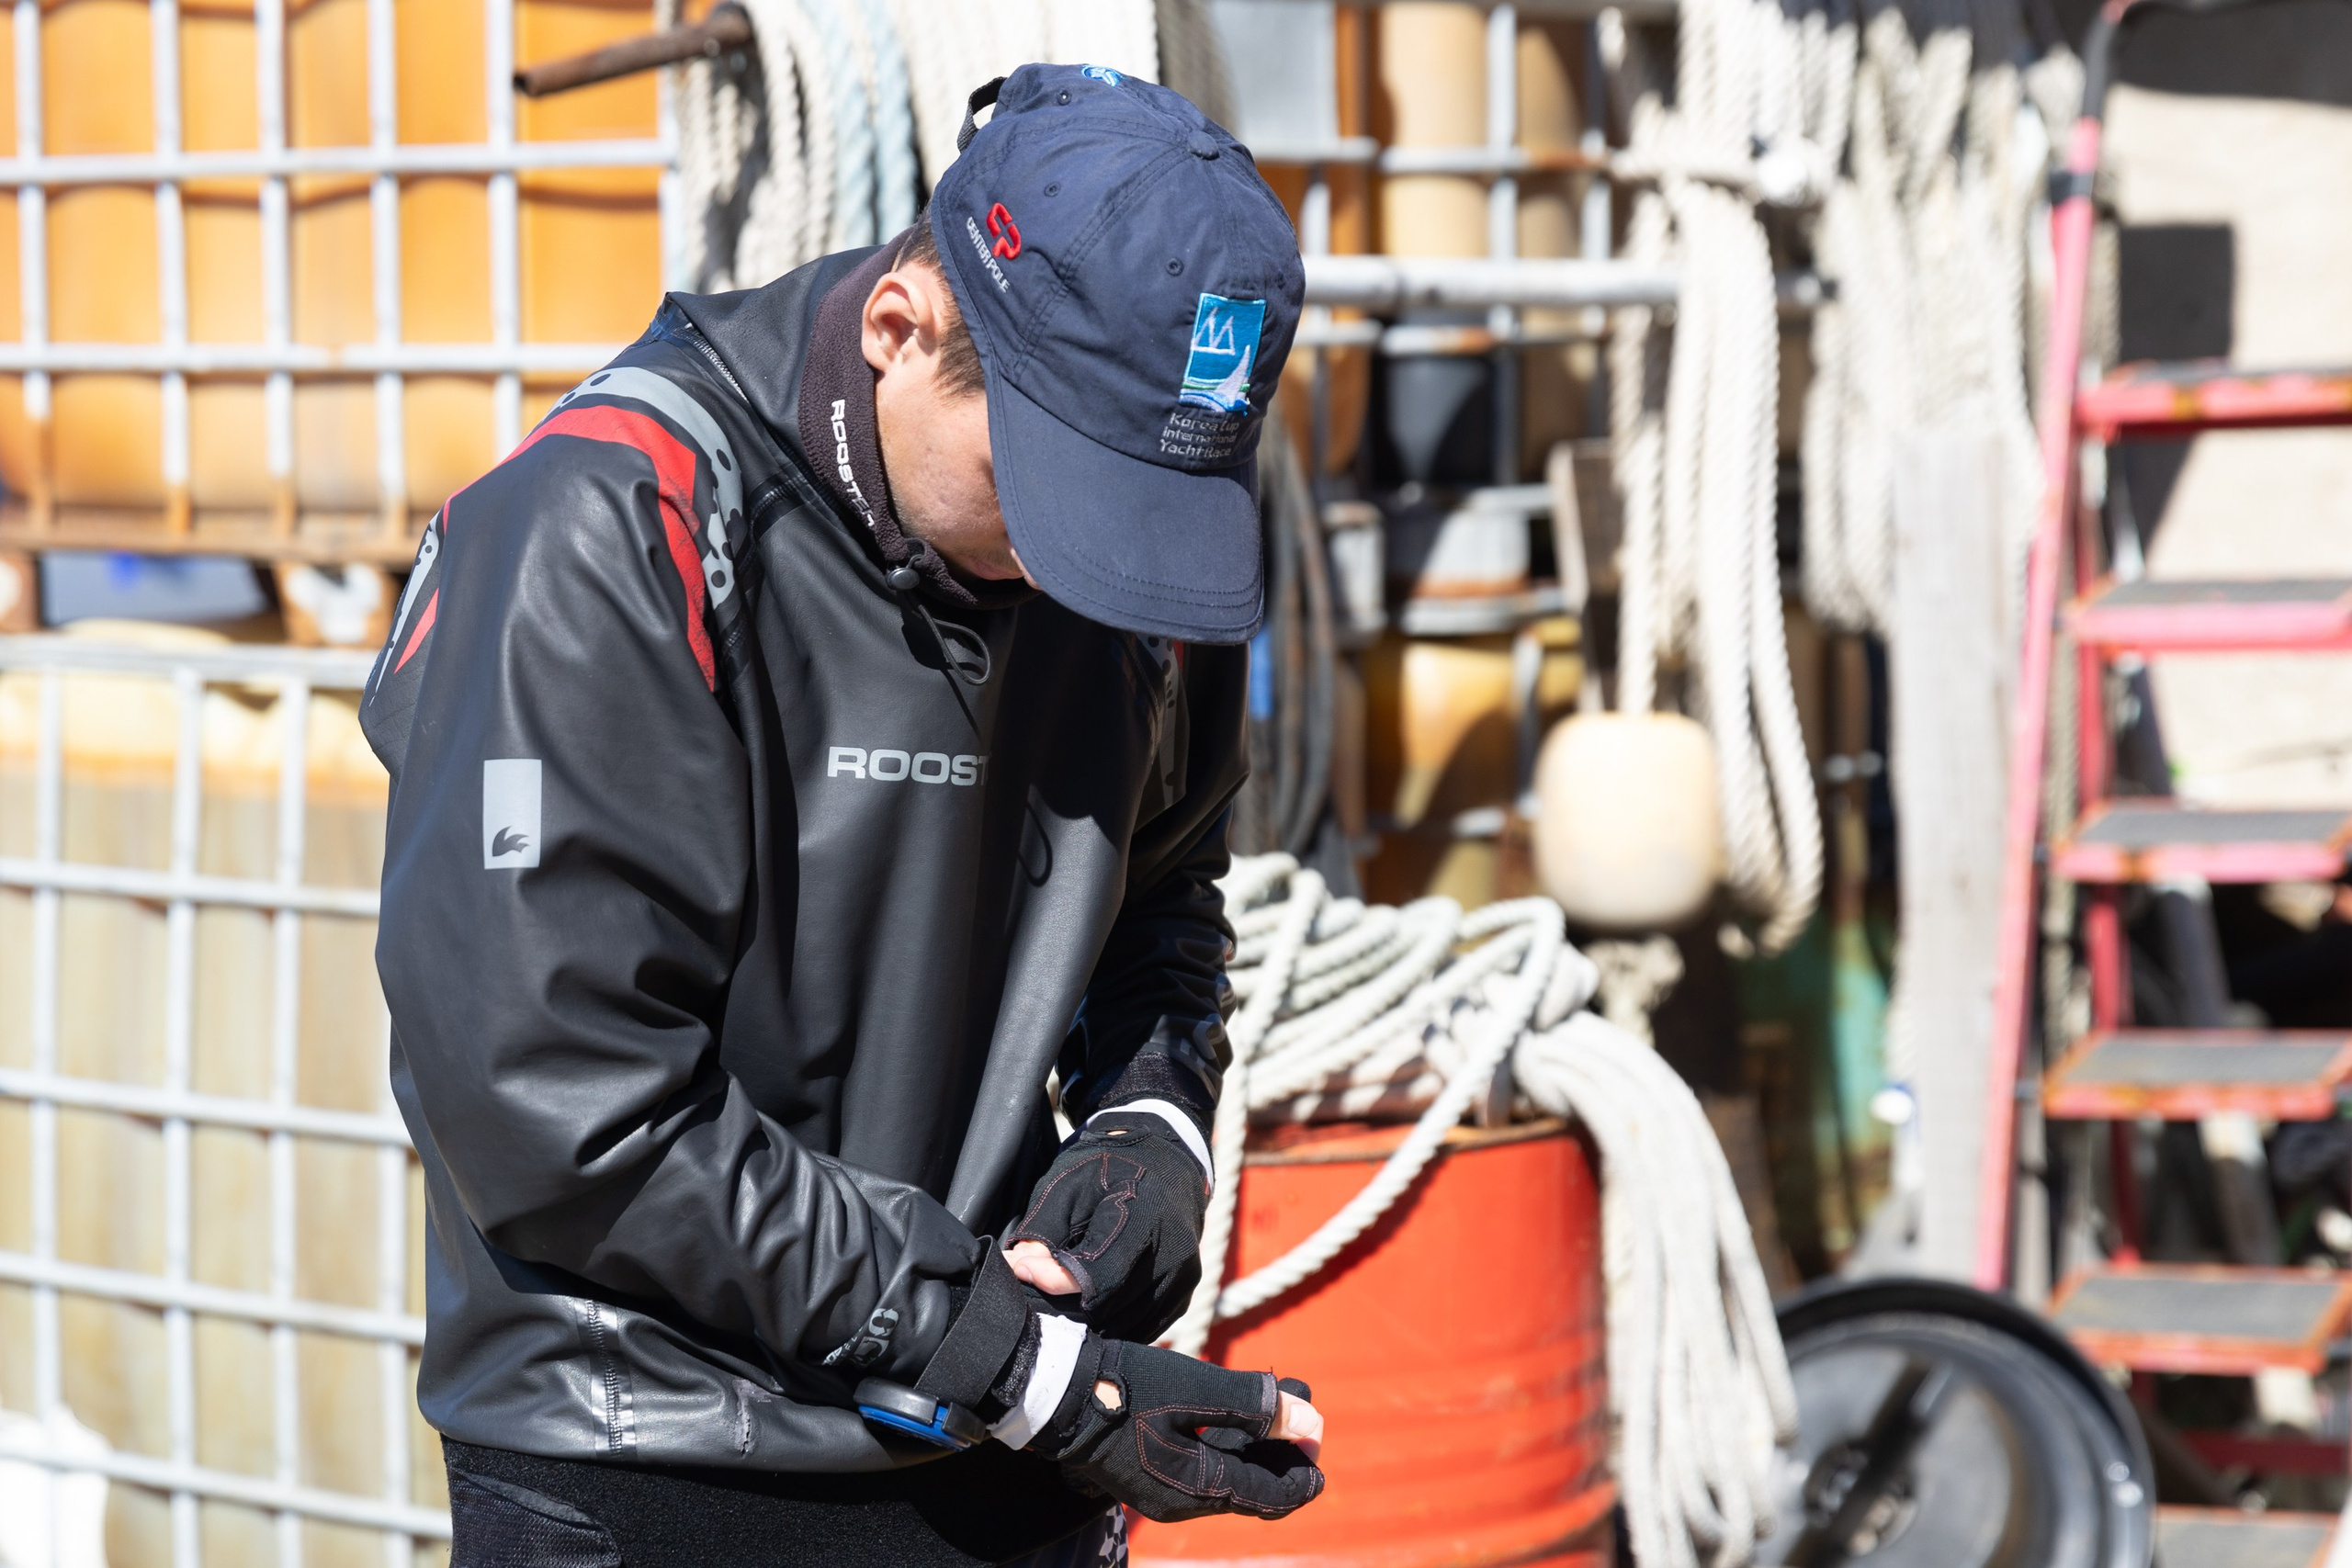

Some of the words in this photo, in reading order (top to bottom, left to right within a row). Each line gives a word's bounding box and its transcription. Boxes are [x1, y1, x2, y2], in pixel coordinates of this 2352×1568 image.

[967, 216, 1011, 293] CENTERPOLE
[1170, 412, 1218, 432] Korea
[1162, 425, 1237, 444] International
[1160, 438, 1205, 457] Yacht
[1204, 446, 1232, 458] Race
